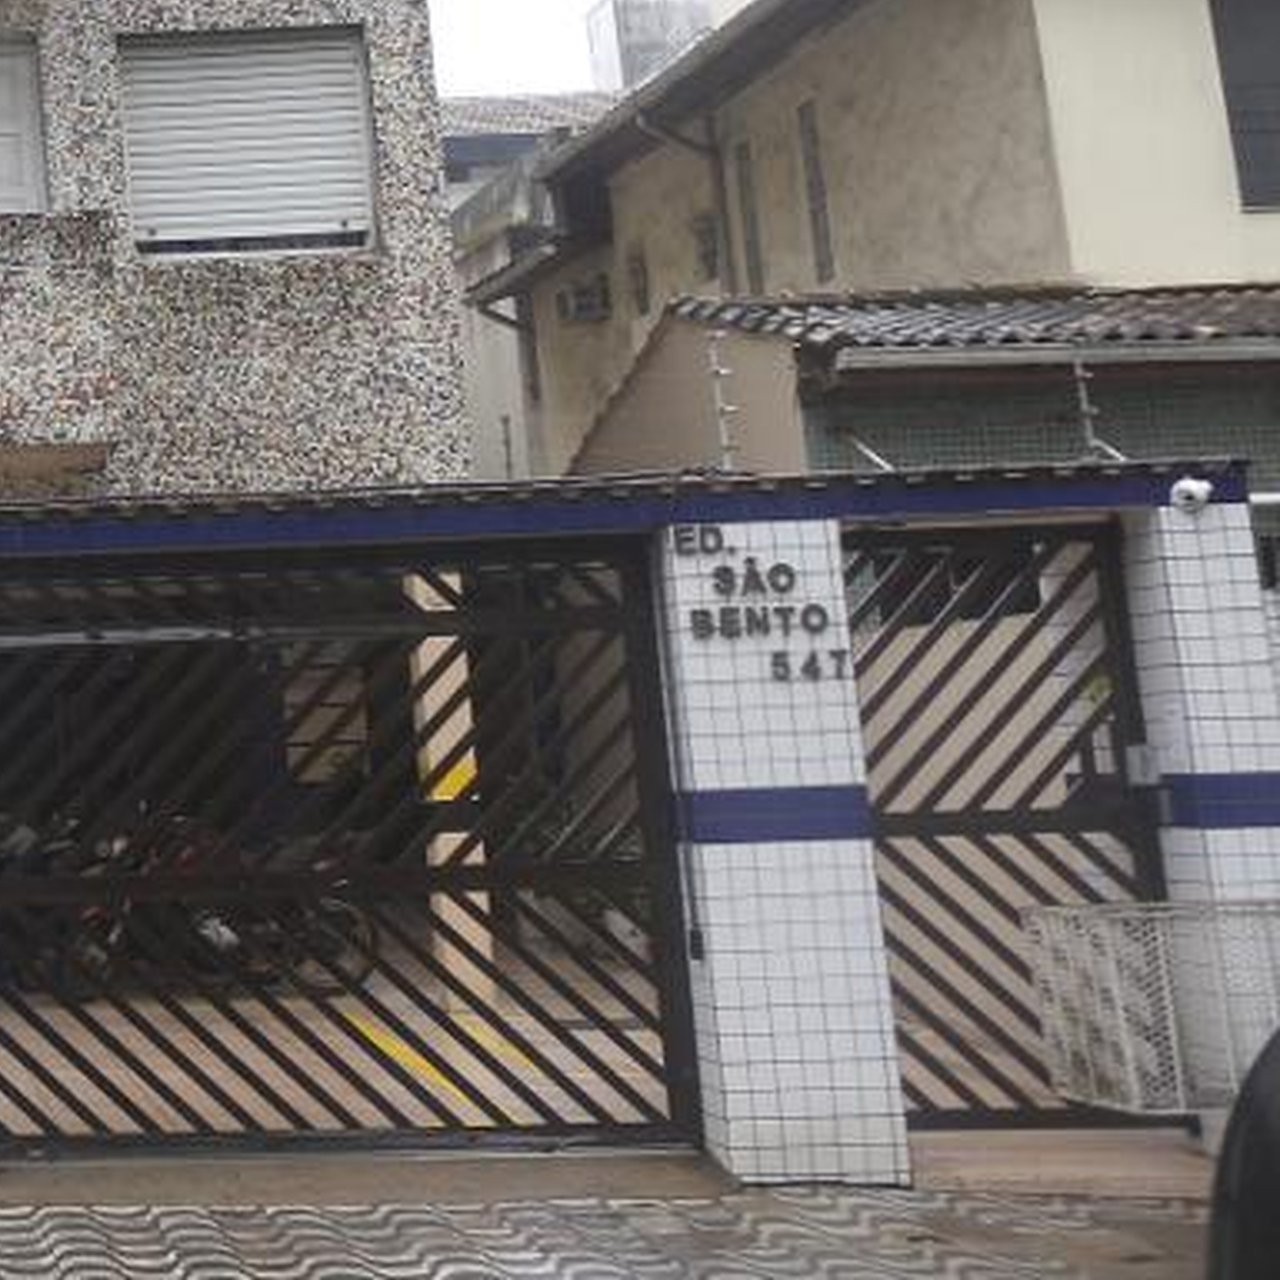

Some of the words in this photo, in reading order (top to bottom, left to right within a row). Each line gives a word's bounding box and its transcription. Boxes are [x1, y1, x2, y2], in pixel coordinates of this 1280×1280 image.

[673, 526, 736, 556] ED.
[713, 557, 796, 595] SÃO
[691, 603, 829, 640] BENTO
[771, 649, 848, 682] 547
